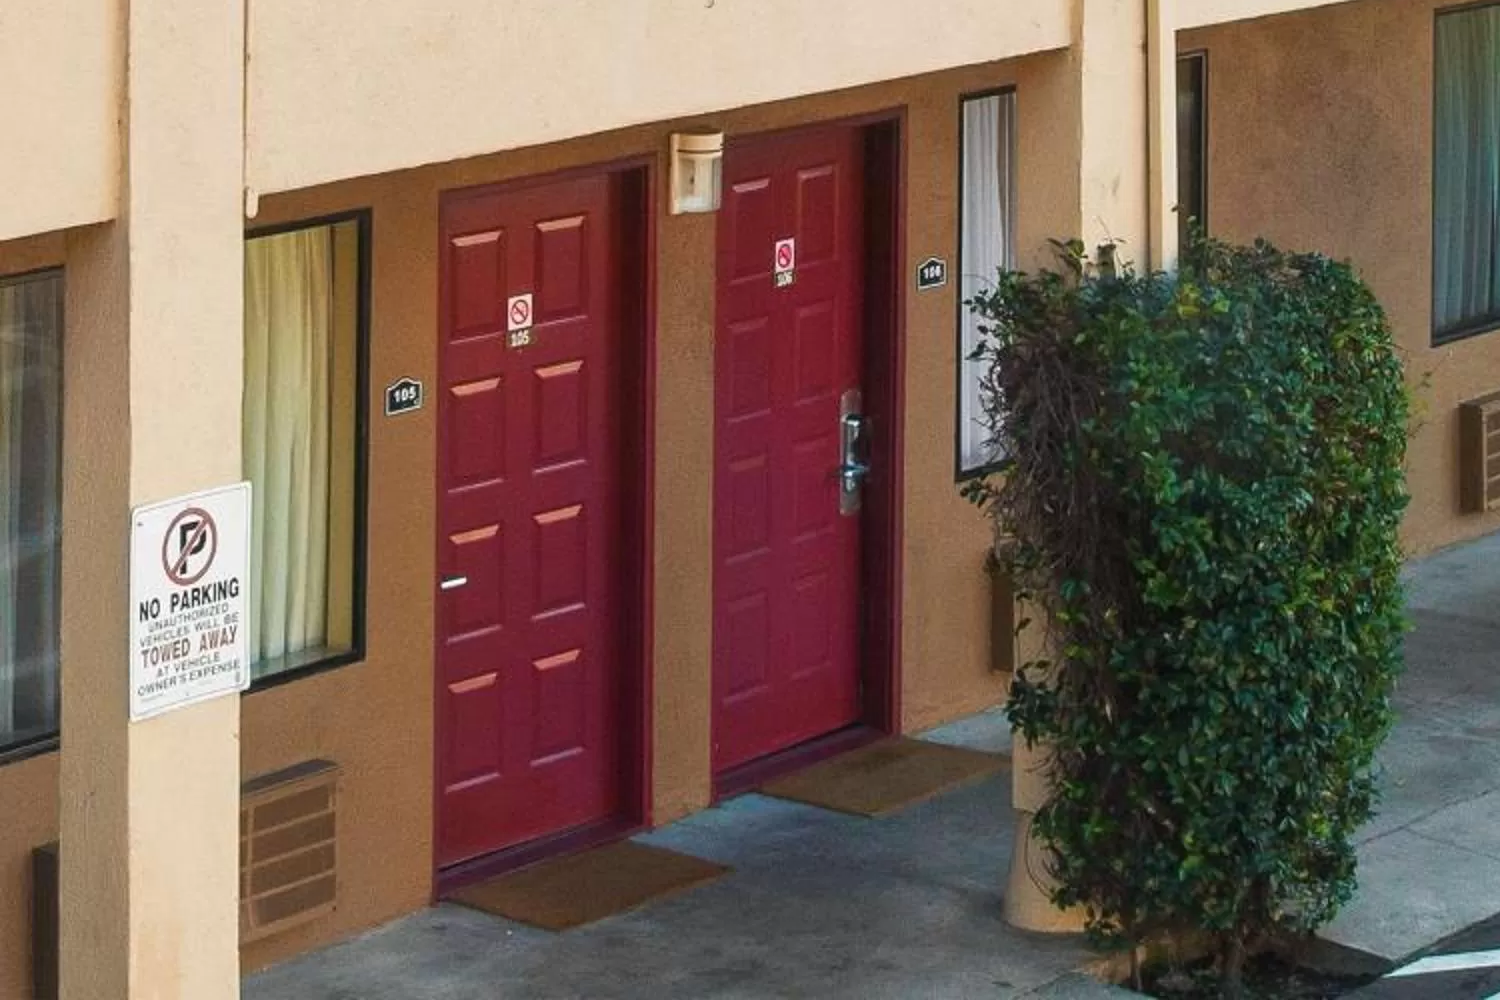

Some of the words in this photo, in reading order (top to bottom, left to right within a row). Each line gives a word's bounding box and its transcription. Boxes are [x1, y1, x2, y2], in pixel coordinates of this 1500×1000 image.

[394, 385, 417, 403] 105
[139, 598, 161, 622] NO
[170, 577, 239, 613] PARKING
[148, 602, 229, 632] UNAUTHORIZED
[140, 625, 190, 647] VEHICLES
[194, 617, 220, 632] WILL
[223, 611, 239, 625] BE
[141, 638, 191, 669] TOWED
[200, 625, 237, 653] AWAY
[138, 674, 186, 697] OWNER'S
[189, 659, 240, 683] EXPENSE
[156, 665, 170, 678] AT
[175, 652, 220, 672] VEHICLE
